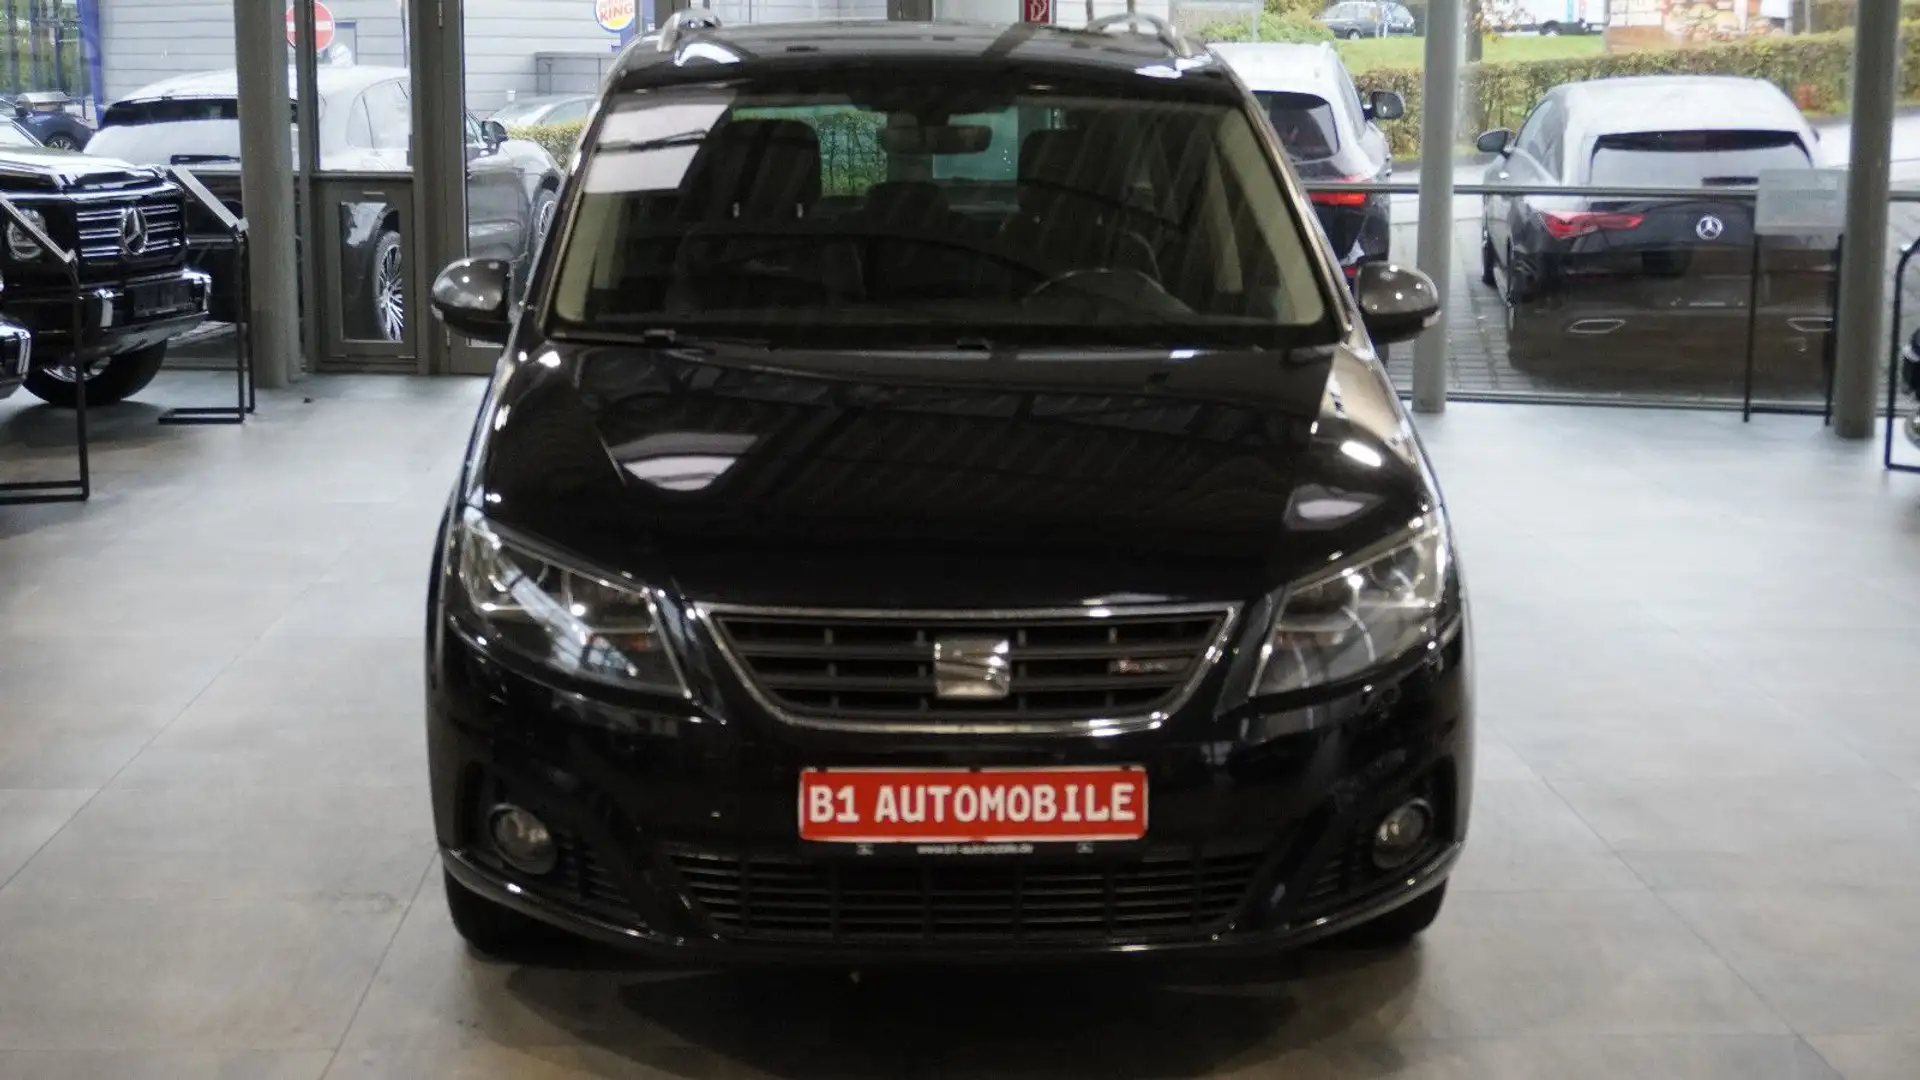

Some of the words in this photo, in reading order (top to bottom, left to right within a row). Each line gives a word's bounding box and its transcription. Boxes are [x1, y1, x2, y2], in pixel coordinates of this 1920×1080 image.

[600, 4, 633, 21] KING
[809, 786, 860, 822] B1
[873, 784, 1136, 822] AUTOMOBILE
